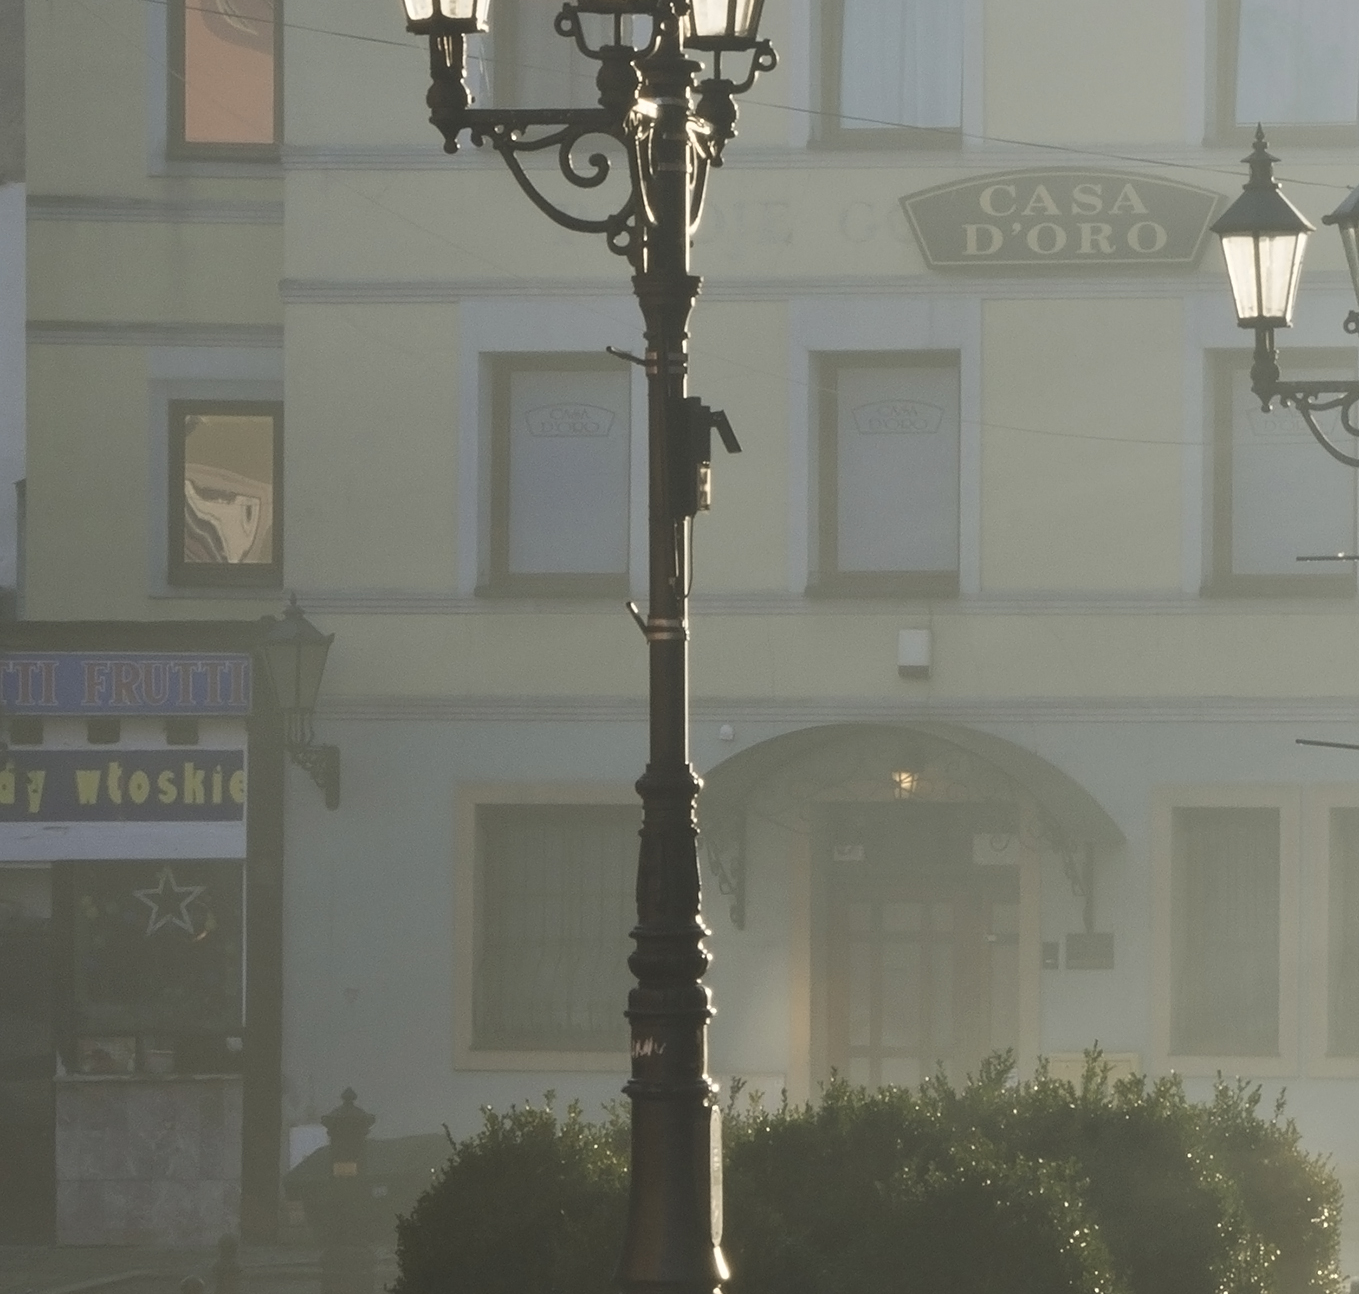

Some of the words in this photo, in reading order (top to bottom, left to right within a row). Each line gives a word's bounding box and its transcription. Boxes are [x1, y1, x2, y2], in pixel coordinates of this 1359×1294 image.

[979, 183, 1149, 217] CASA
[961, 221, 1168, 257] D'ORO
[81, 660, 248, 706] FRUTTI
